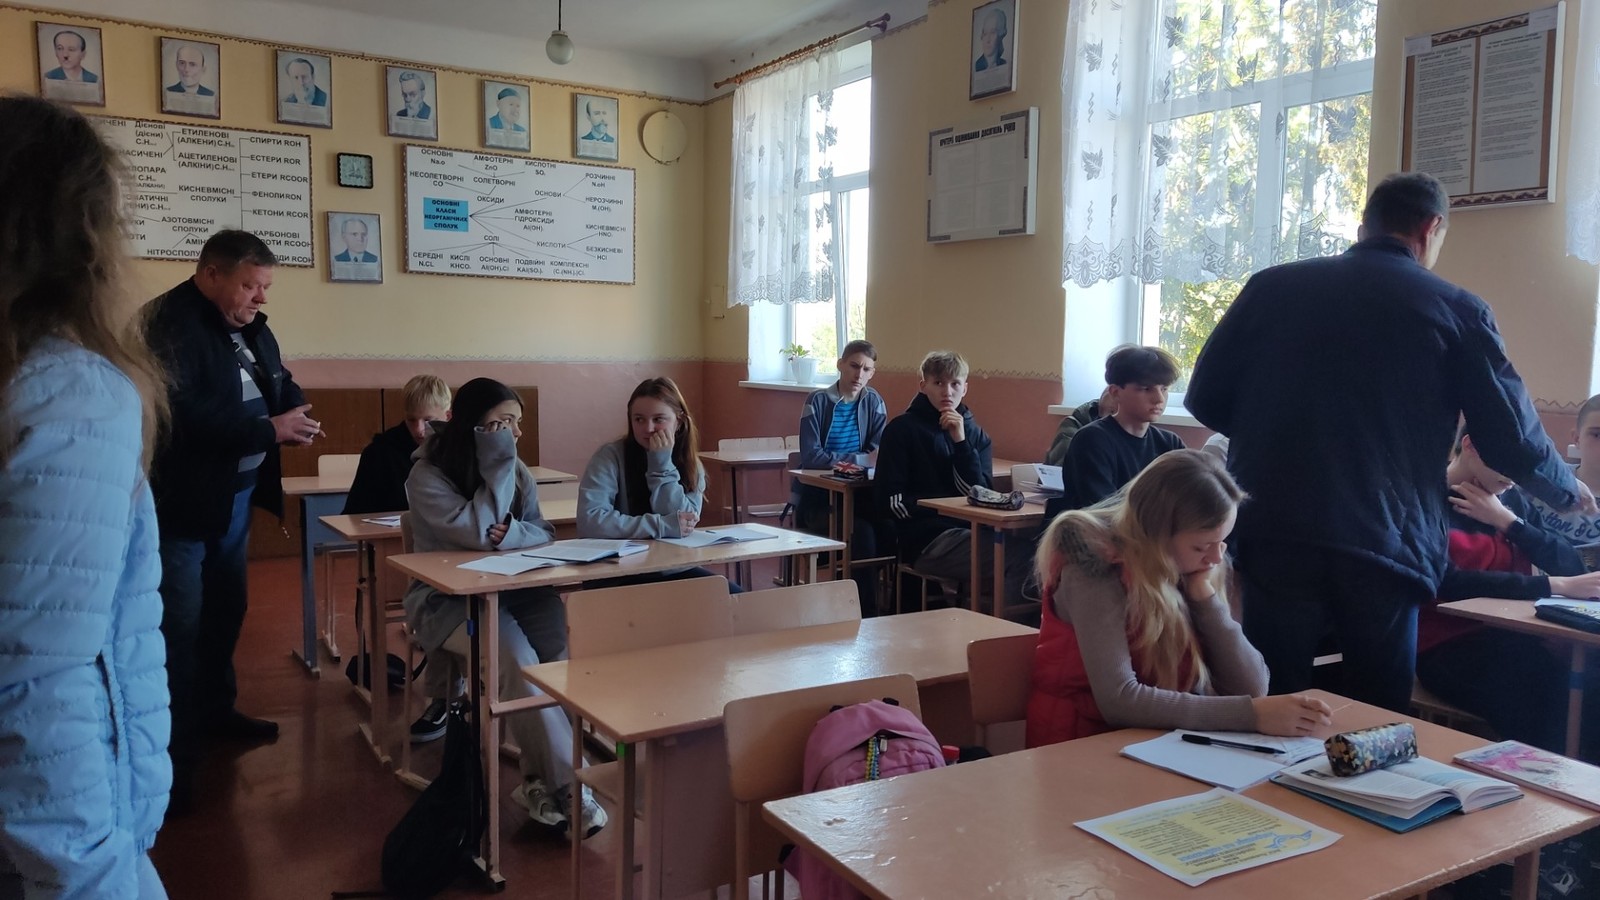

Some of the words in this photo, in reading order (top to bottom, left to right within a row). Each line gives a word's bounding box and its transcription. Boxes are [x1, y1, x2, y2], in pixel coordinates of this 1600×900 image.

[181, 128, 230, 139] ЕТИЛЕНОВІ
[249, 136, 282, 146] СПИРТИ
[178, 152, 238, 163] АЦЕТИЛЕНОВІ
[421, 148, 454, 158] ОСНОВНІ
[250, 154, 282, 164] ЕСТЕРИ
[473, 154, 514, 165] АМФОТЕРНІ
[251, 171, 278, 180] ЕТЕРИ
[409, 170, 464, 182] НЕСОЛЕТВОРНІ
[473, 176, 516, 187] СОЛЕТВОРНІ
[178, 185, 235, 195] КИСНЕВМІСНІ
[534, 189, 562, 198] ОСНОВИ
[190, 194, 227, 203] СПОЛУКИ
[431, 199, 460, 207] ОСНОВНІ
[476, 195, 505, 204] ОКСИДИ
[252, 209, 285, 217] КЕТОНИ
[514, 208, 553, 217] АМФОТЕРНІ
[161, 216, 215, 225] АЗОТОВМІСНІ
[172, 225, 209, 233] СПОЛУКИ
[433, 222, 459, 230] СПОЛУК
[253, 230, 300, 239] КАРБОНОВІ
[146, 248, 201, 257] НІТРОСПОЛУ
[412, 251, 444, 260] СЕРЕДНІ
[479, 255, 510, 264] ОСНОВНІ
